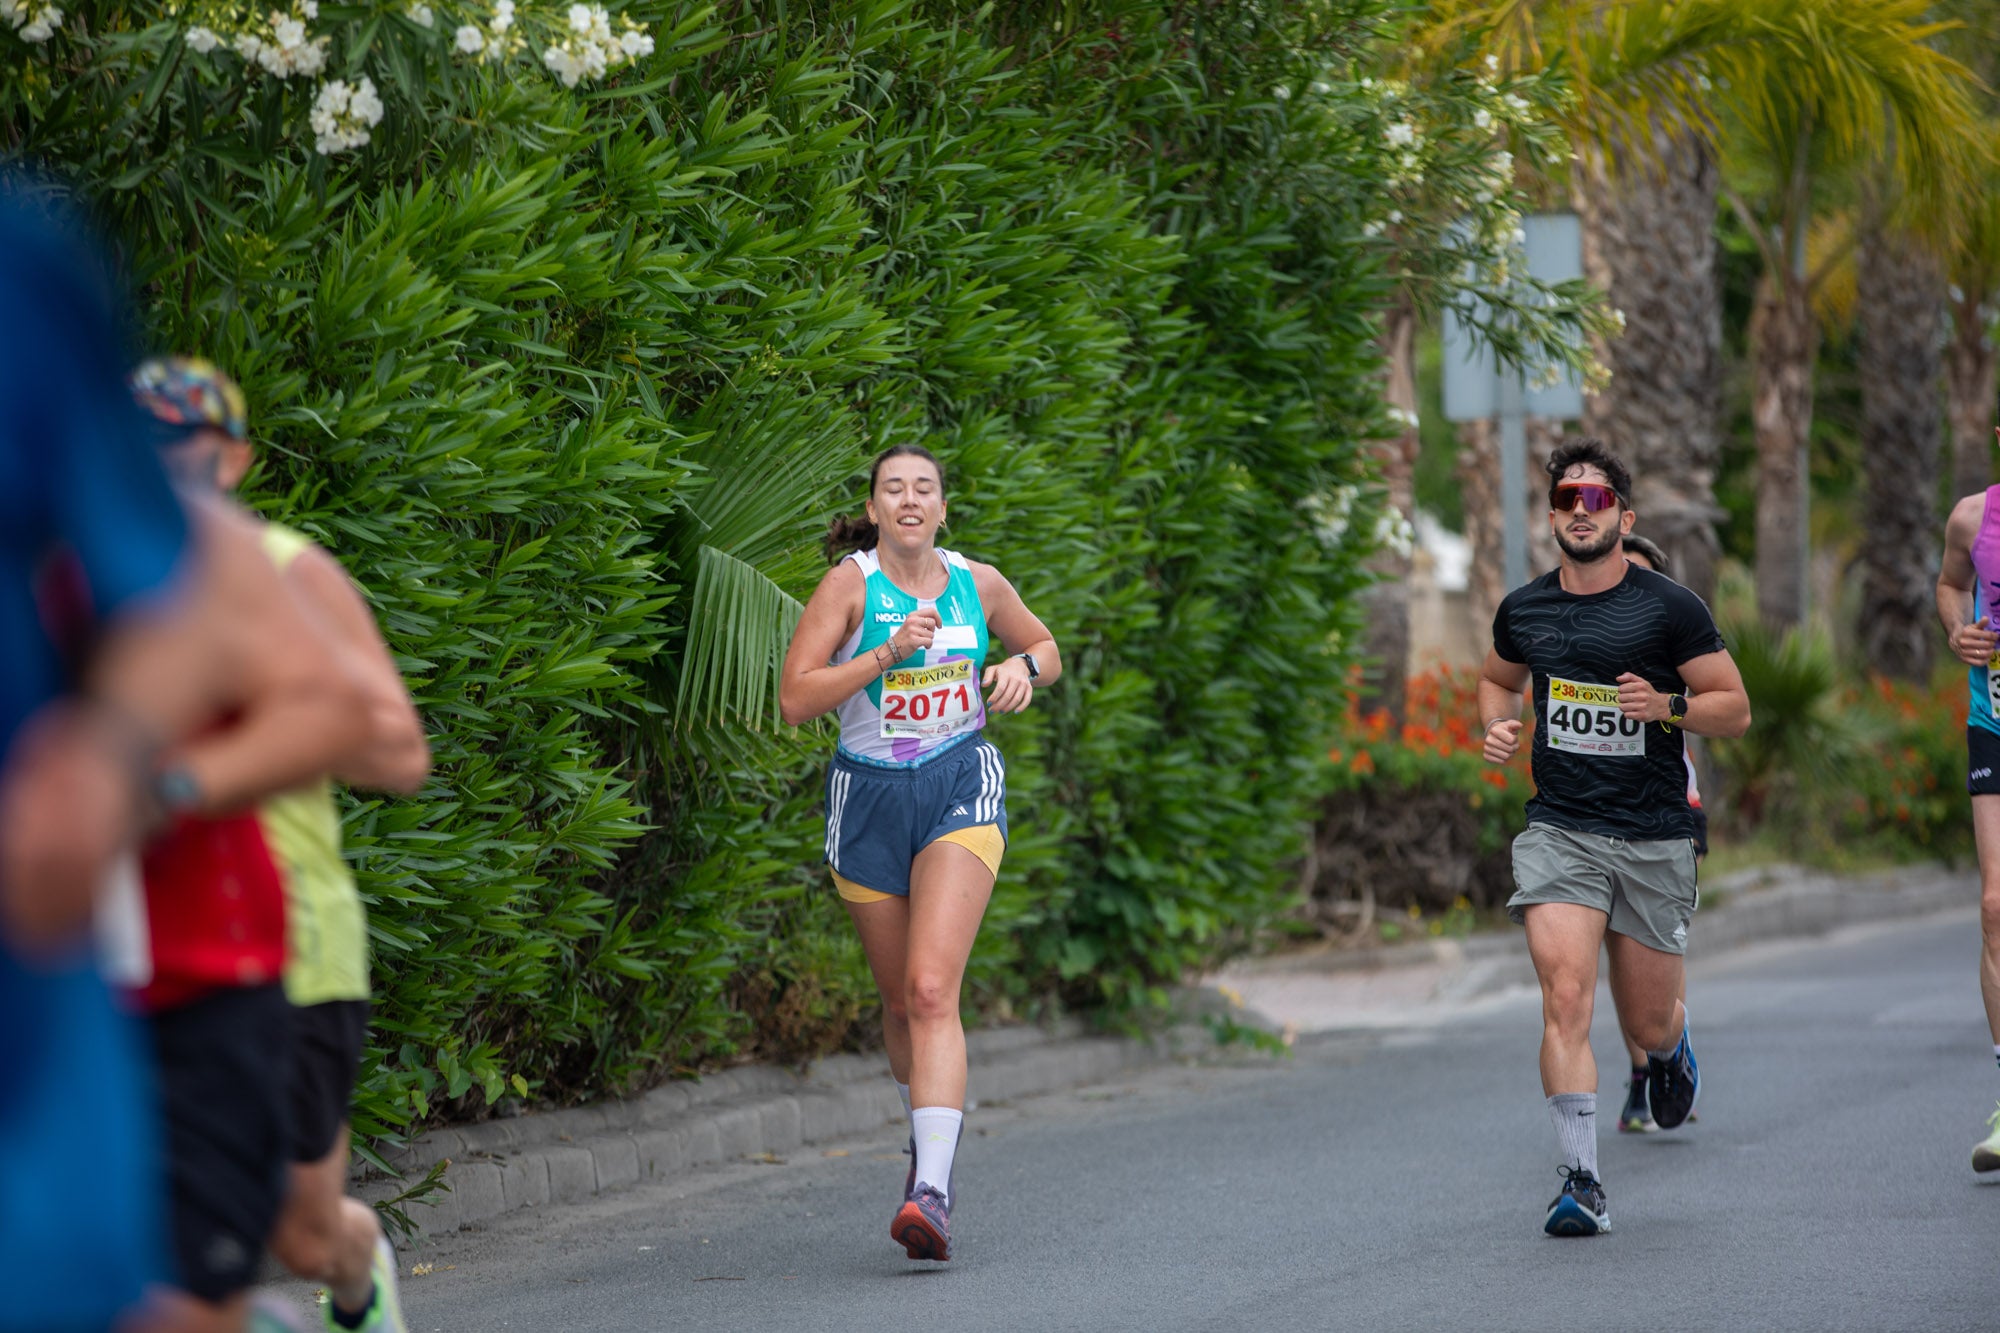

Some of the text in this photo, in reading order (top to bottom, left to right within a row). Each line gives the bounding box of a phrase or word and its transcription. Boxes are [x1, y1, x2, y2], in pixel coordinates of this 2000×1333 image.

[897, 669, 954, 686] 38 FONDO
[884, 684, 970, 721] 2071
[1561, 684, 1575, 697] 38
[1550, 705, 1640, 737] 4050
